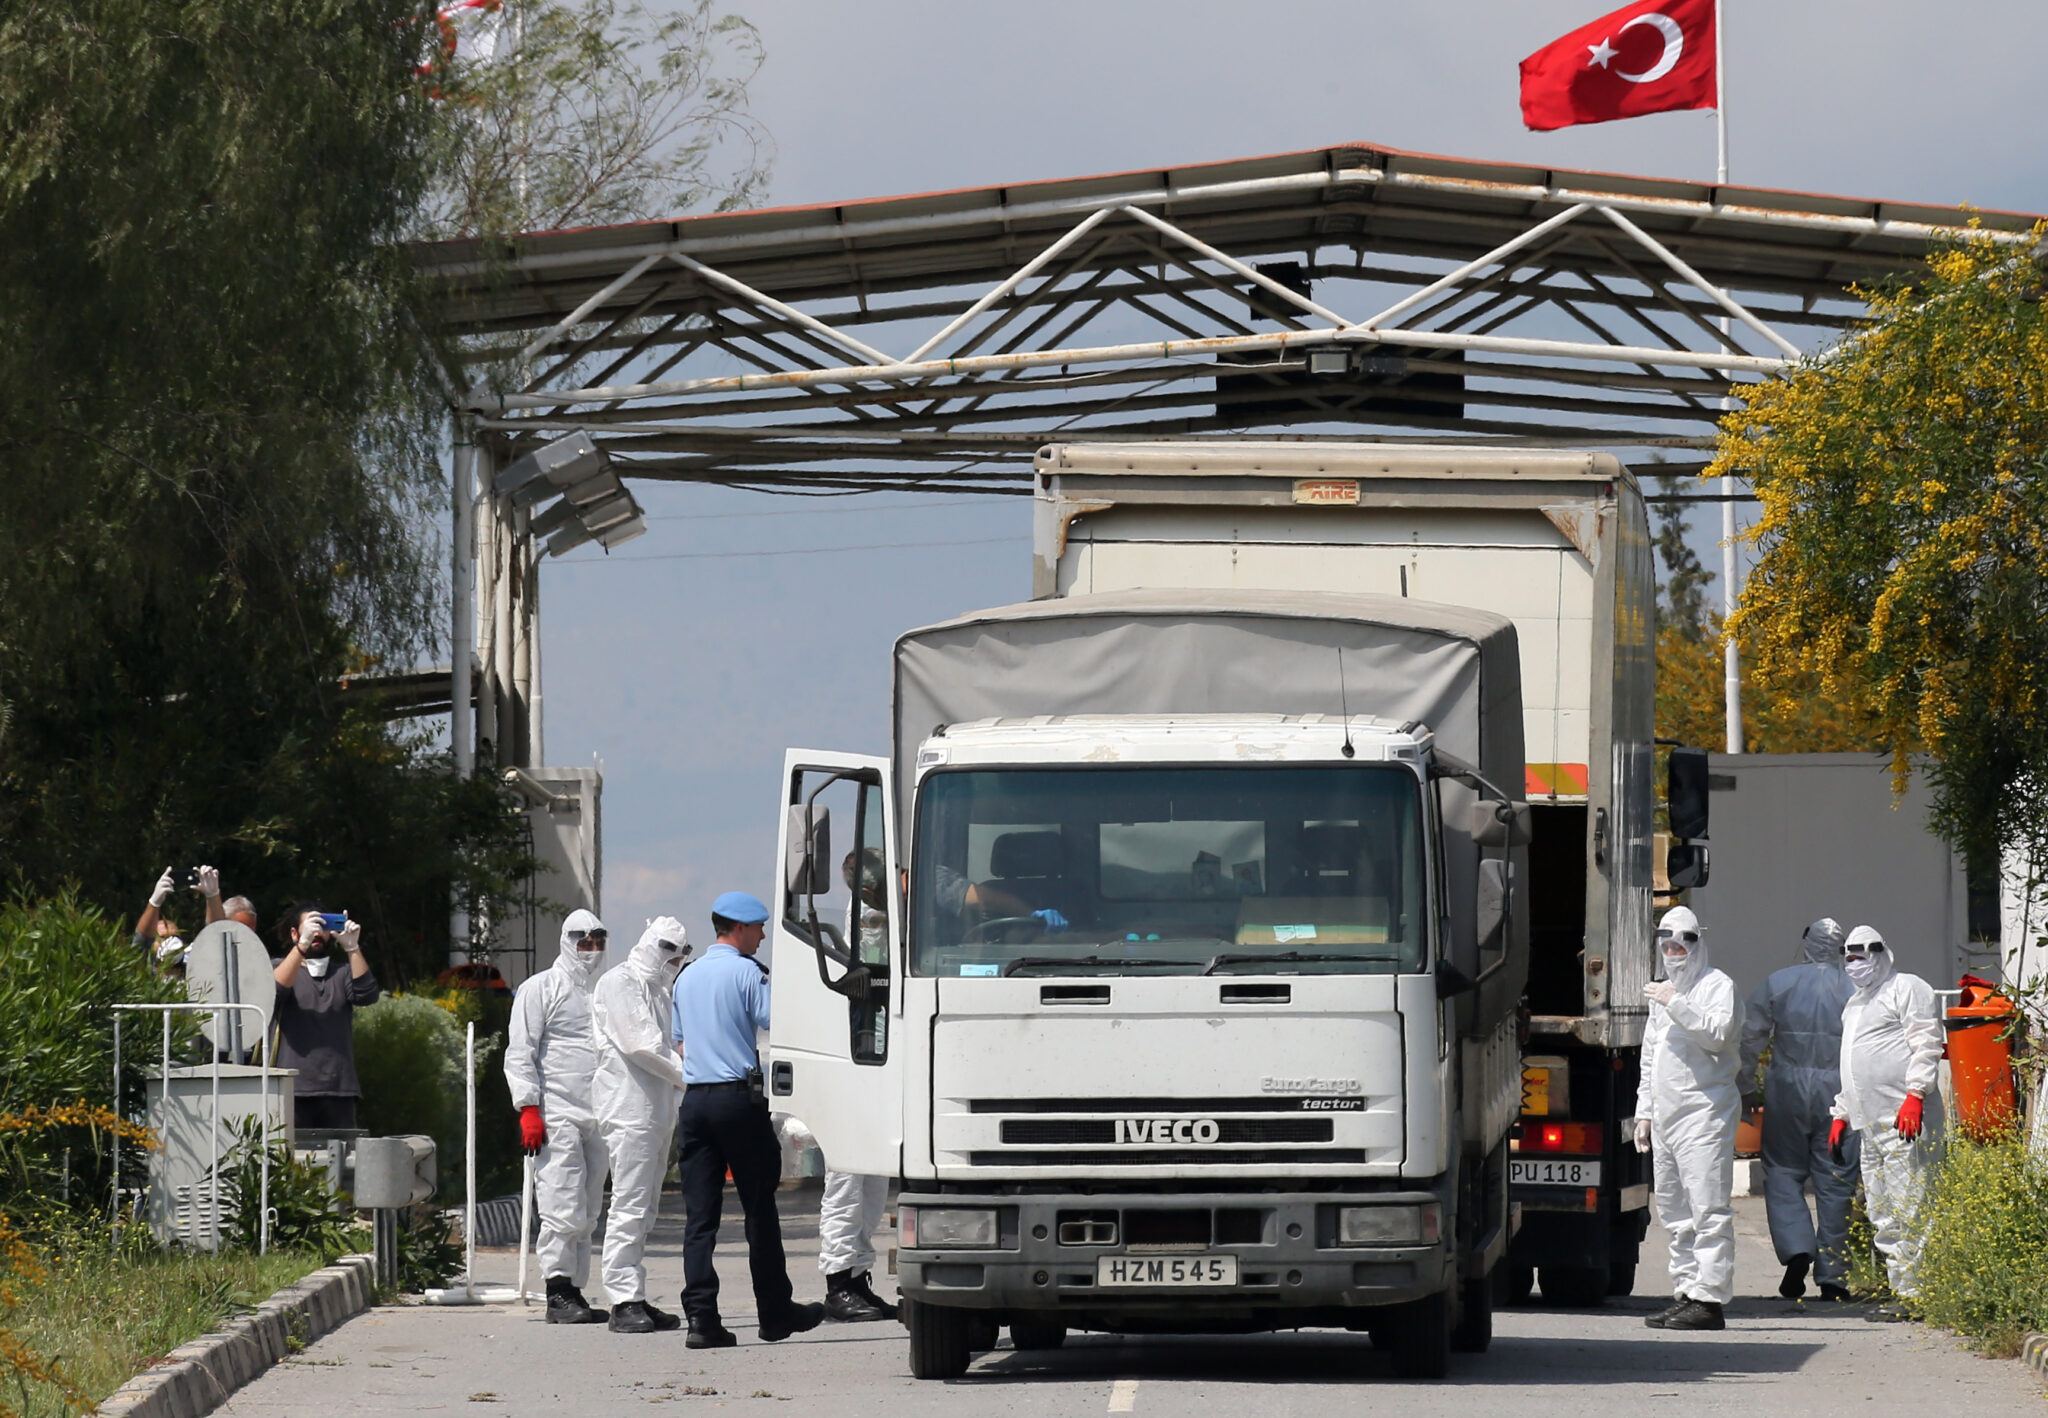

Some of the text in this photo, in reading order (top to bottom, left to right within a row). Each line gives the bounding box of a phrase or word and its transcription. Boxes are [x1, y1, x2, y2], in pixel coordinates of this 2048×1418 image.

[1301, 1098, 1361, 1109] tector
[1115, 1119, 1220, 1143] IVECO
[1511, 1163, 1582, 1183] PU 118
[1111, 1260, 1222, 1282] HZM 545
